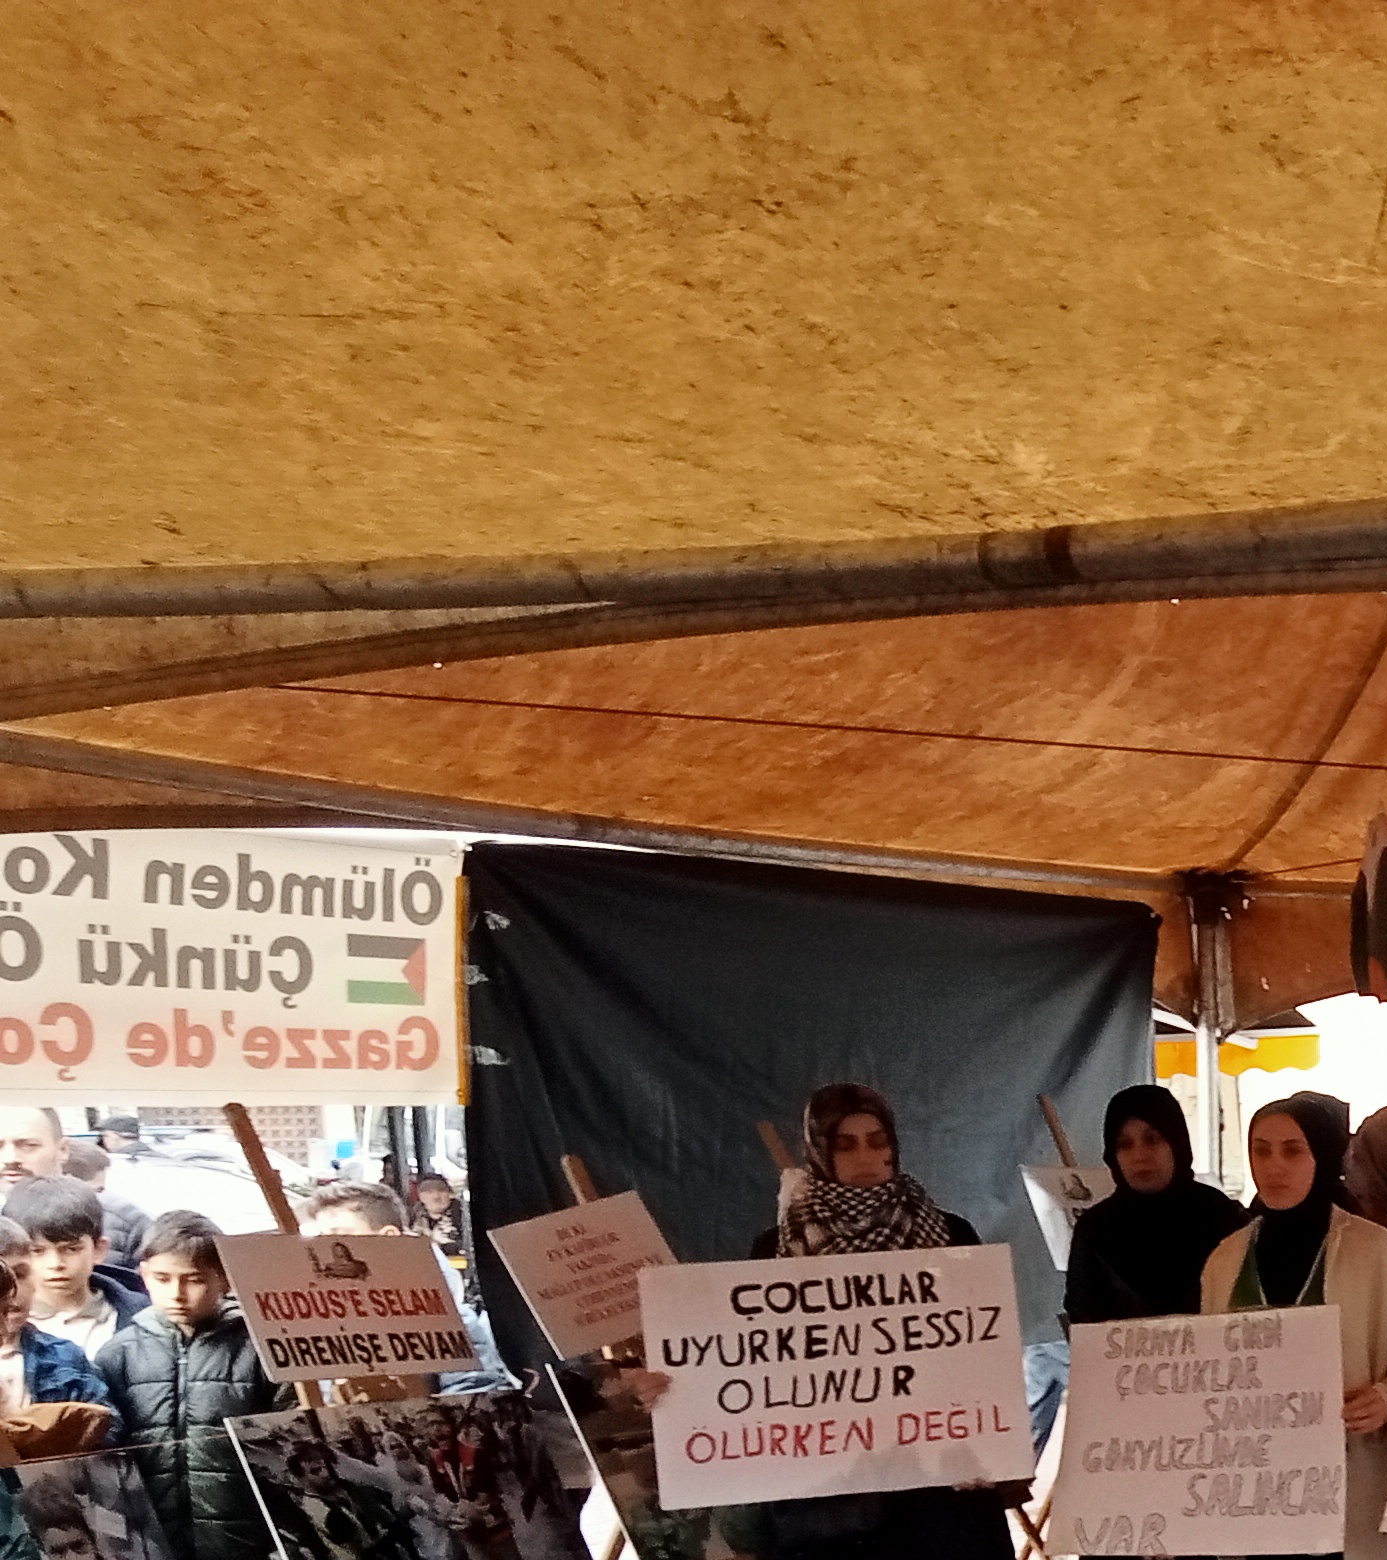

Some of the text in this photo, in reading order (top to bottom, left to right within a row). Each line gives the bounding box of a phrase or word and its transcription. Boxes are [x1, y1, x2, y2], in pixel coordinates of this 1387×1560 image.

[368, 1286, 449, 1318] SELAM
[731, 1271, 939, 1321] ÇOCUKLAR
[265, 1326, 474, 1372] DİRENİŞE DEVAM
[662, 1305, 1002, 1368] UYURKEN SESSİZ
[718, 1365, 916, 1414] OLUNUR
[1115, 1355, 1263, 1401] ÇOCUKLAR
[686, 1401, 1011, 1463] ÖLÜRKEN DEĞİL
[1074, 1512, 1169, 1556] VAR
